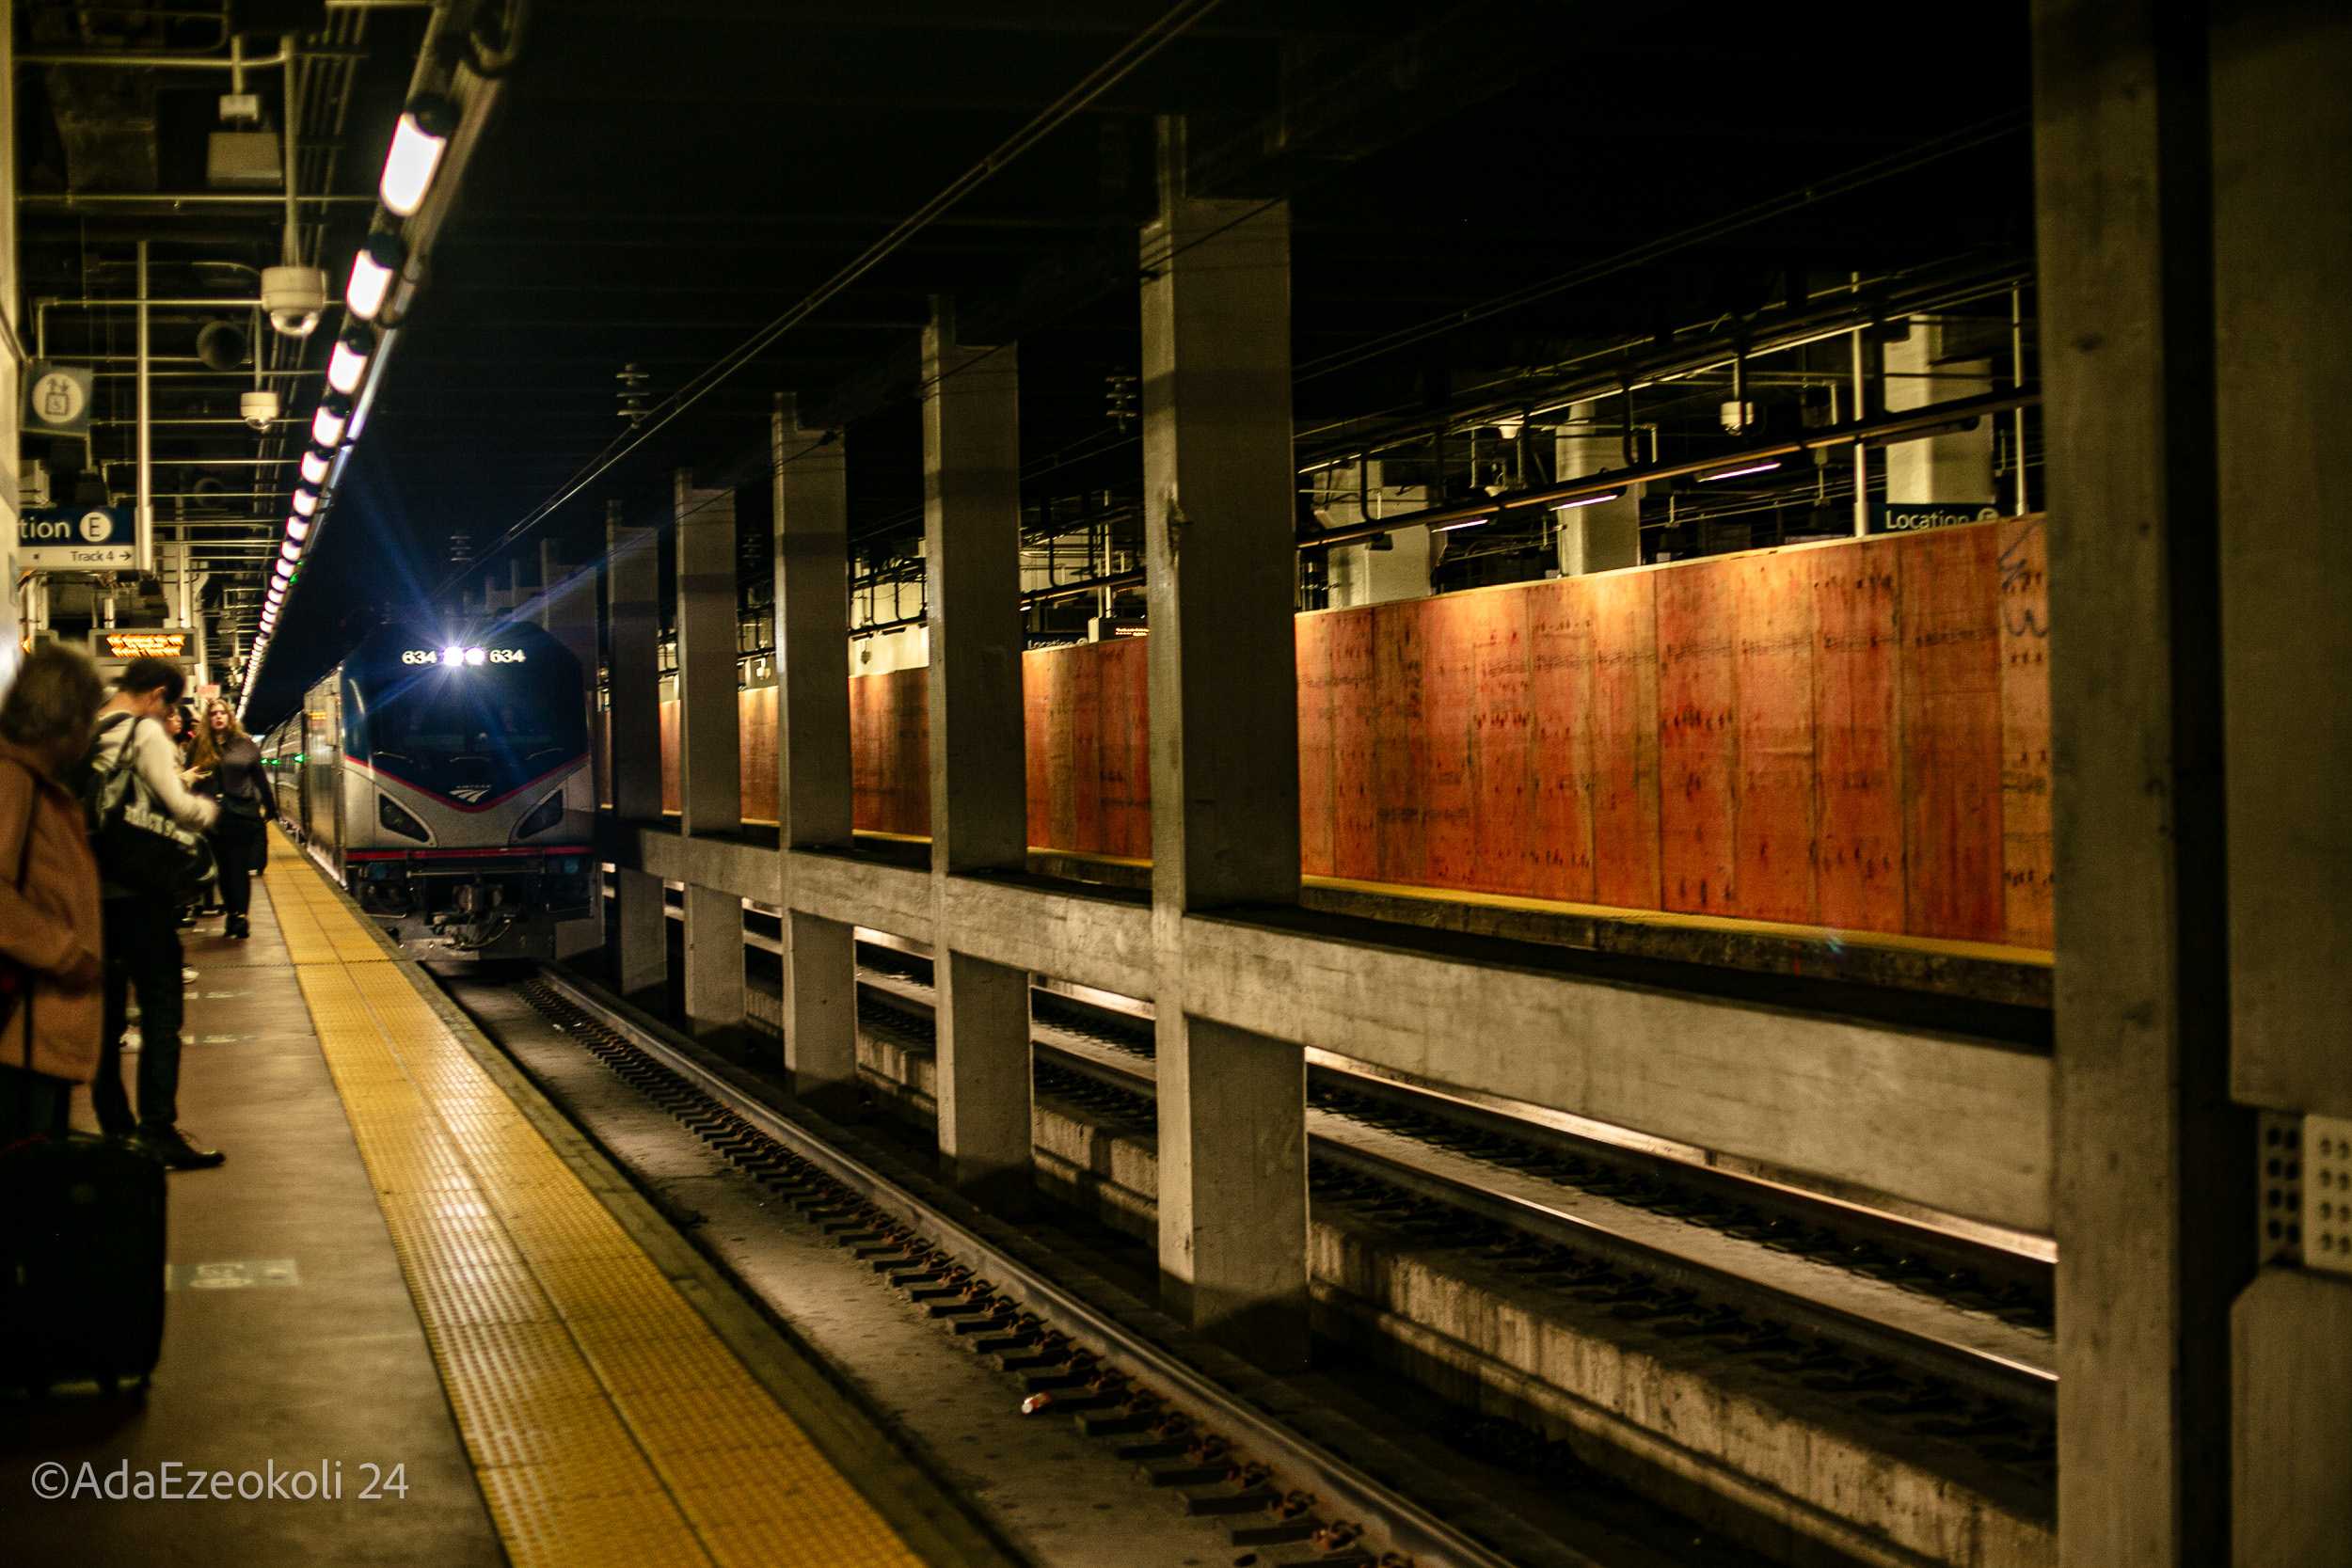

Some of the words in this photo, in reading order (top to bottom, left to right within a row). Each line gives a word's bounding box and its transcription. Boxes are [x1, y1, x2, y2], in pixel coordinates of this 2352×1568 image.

[88, 516, 102, 538] E
[1885, 510, 1970, 530] Location
[70, 550, 103, 562] Track
[105, 550, 115, 562] 4
[402, 650, 437, 665] 634
[489, 649, 526, 663] 634
